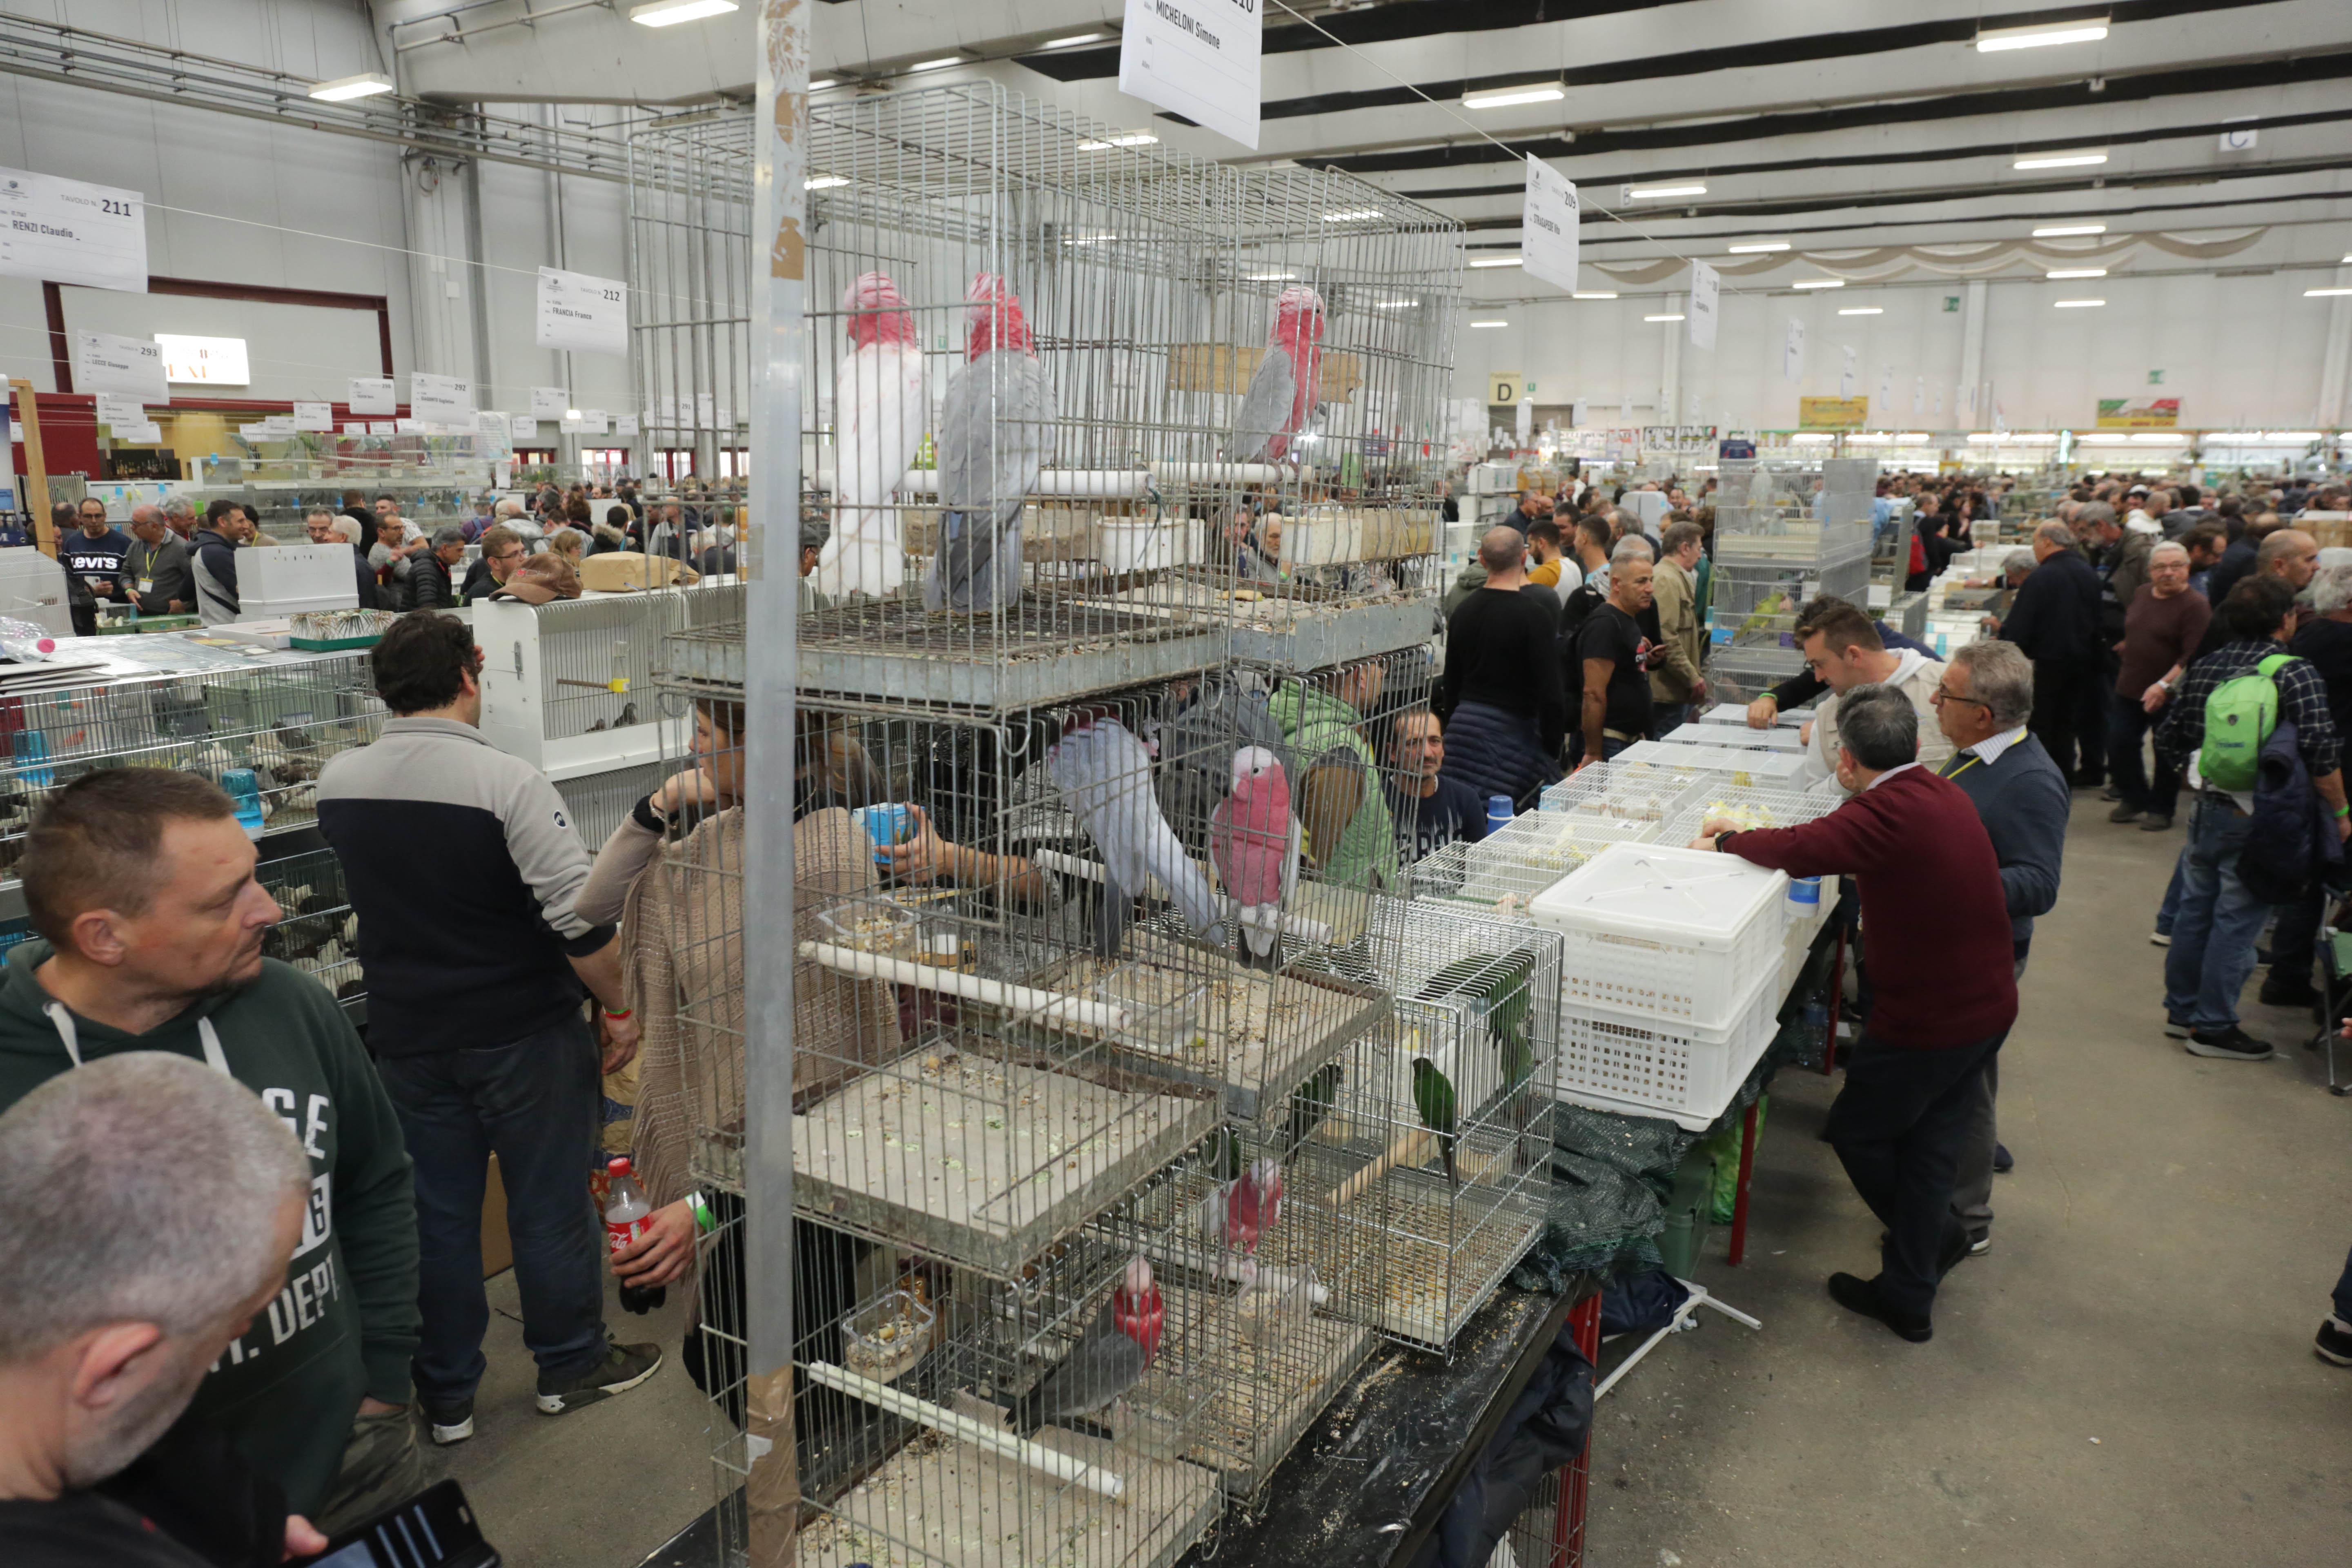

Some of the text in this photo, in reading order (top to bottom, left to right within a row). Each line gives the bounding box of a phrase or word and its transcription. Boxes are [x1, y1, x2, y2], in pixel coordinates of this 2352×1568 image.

[1156, 0, 1194, 34] MICHELONI
[1196, 22, 1220, 49] Simone
[60, 194, 89, 205] TAVOLO
[102, 199, 131, 217] 211
[1565, 191, 1576, 209] 209
[12, 220, 38, 233] RENZI
[41, 224, 73, 238] Claudio
[604, 289, 620, 302] 212
[552, 307, 592, 320] FRANCIA Franco
[141, 347, 158, 357] 293
[454, 384, 466, 392] 292
[1498, 383, 1512, 401] D
